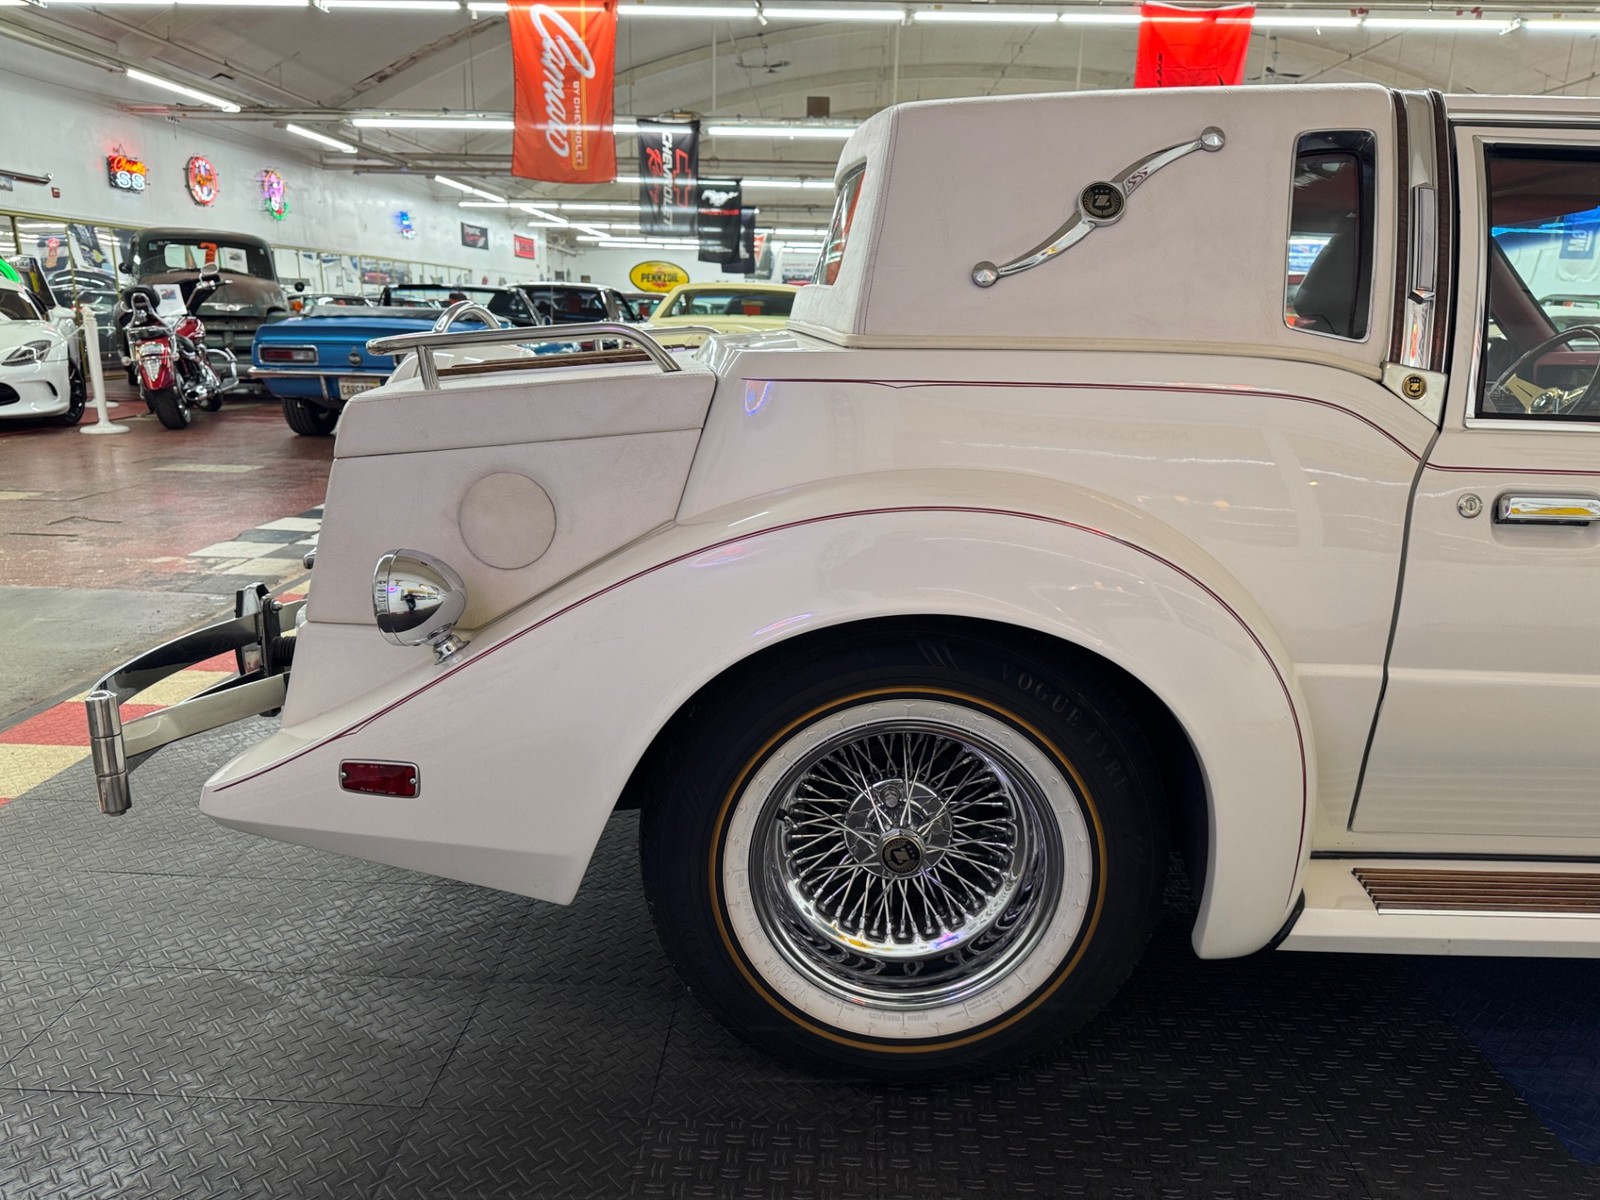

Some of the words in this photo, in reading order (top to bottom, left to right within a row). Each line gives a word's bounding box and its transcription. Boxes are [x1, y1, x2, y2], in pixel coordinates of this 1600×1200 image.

[530, 4, 596, 158] Camaro
[572, 80, 580, 96] BY
[573, 97, 584, 165] CHEVROLET
[116, 171, 145, 190] SS
[661, 131, 674, 229] CHEVROLET
[640, 272, 679, 283] PENNZOIL
[1002, 662, 1082, 727] VOGUE
